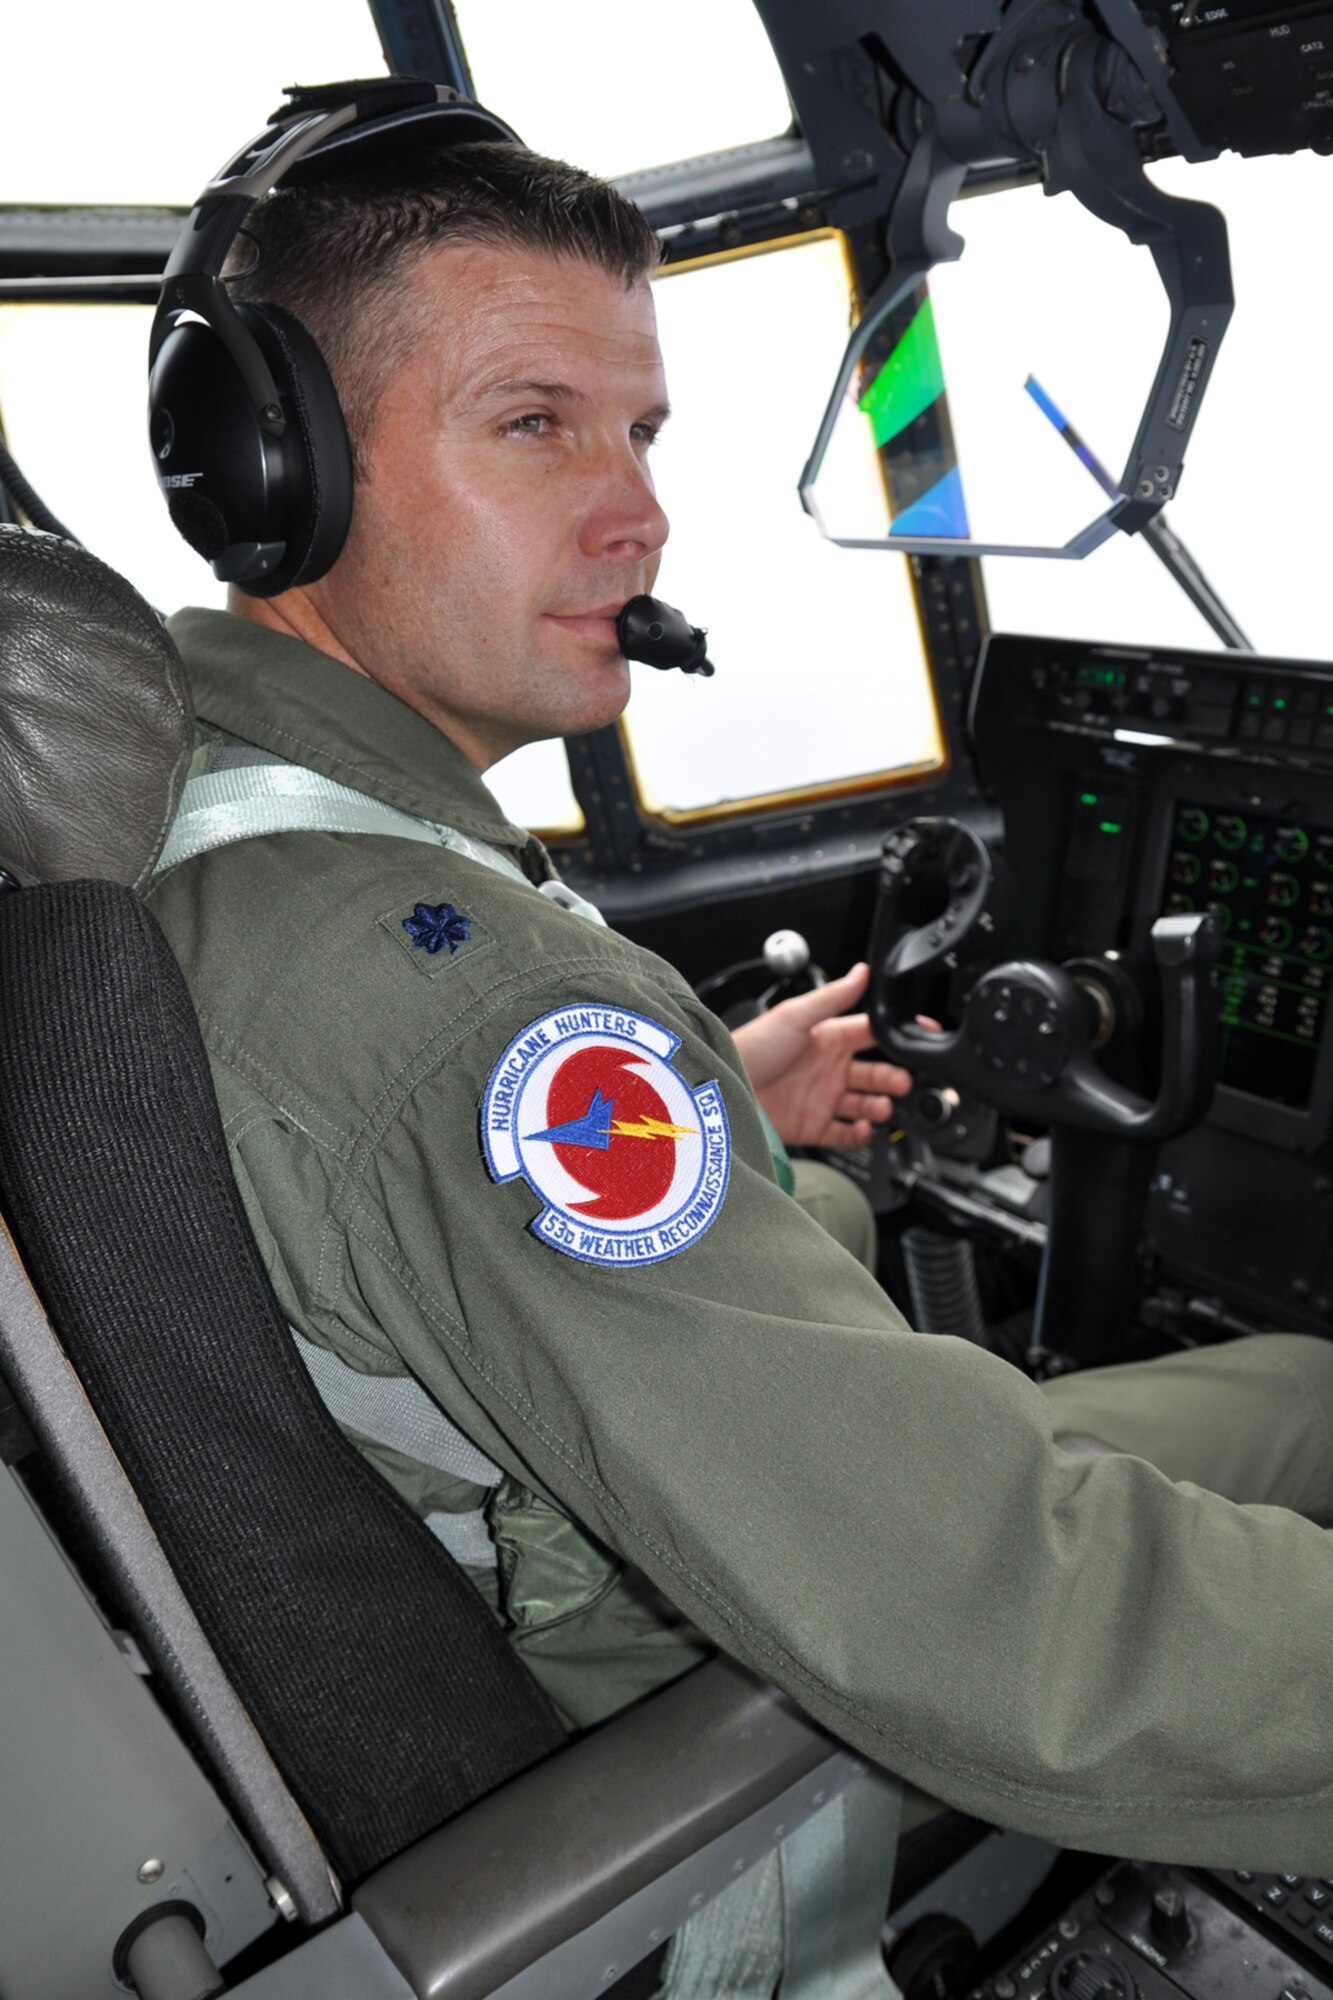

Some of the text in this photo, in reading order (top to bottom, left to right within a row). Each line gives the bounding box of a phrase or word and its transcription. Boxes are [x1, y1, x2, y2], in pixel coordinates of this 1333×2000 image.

[1204, 8, 1229, 20] EDGE
[1270, 24, 1290, 36] HUD
[159, 472, 203, 488] OSE
[491, 1012, 636, 1131] HURRICANE HUNTERS
[579, 1231, 655, 1257] WEATHER
[661, 1124, 725, 1250] RECONNAISSANCE
[700, 1090, 719, 1117] SQ
[1130, 1934, 1167, 1966] HEADING
